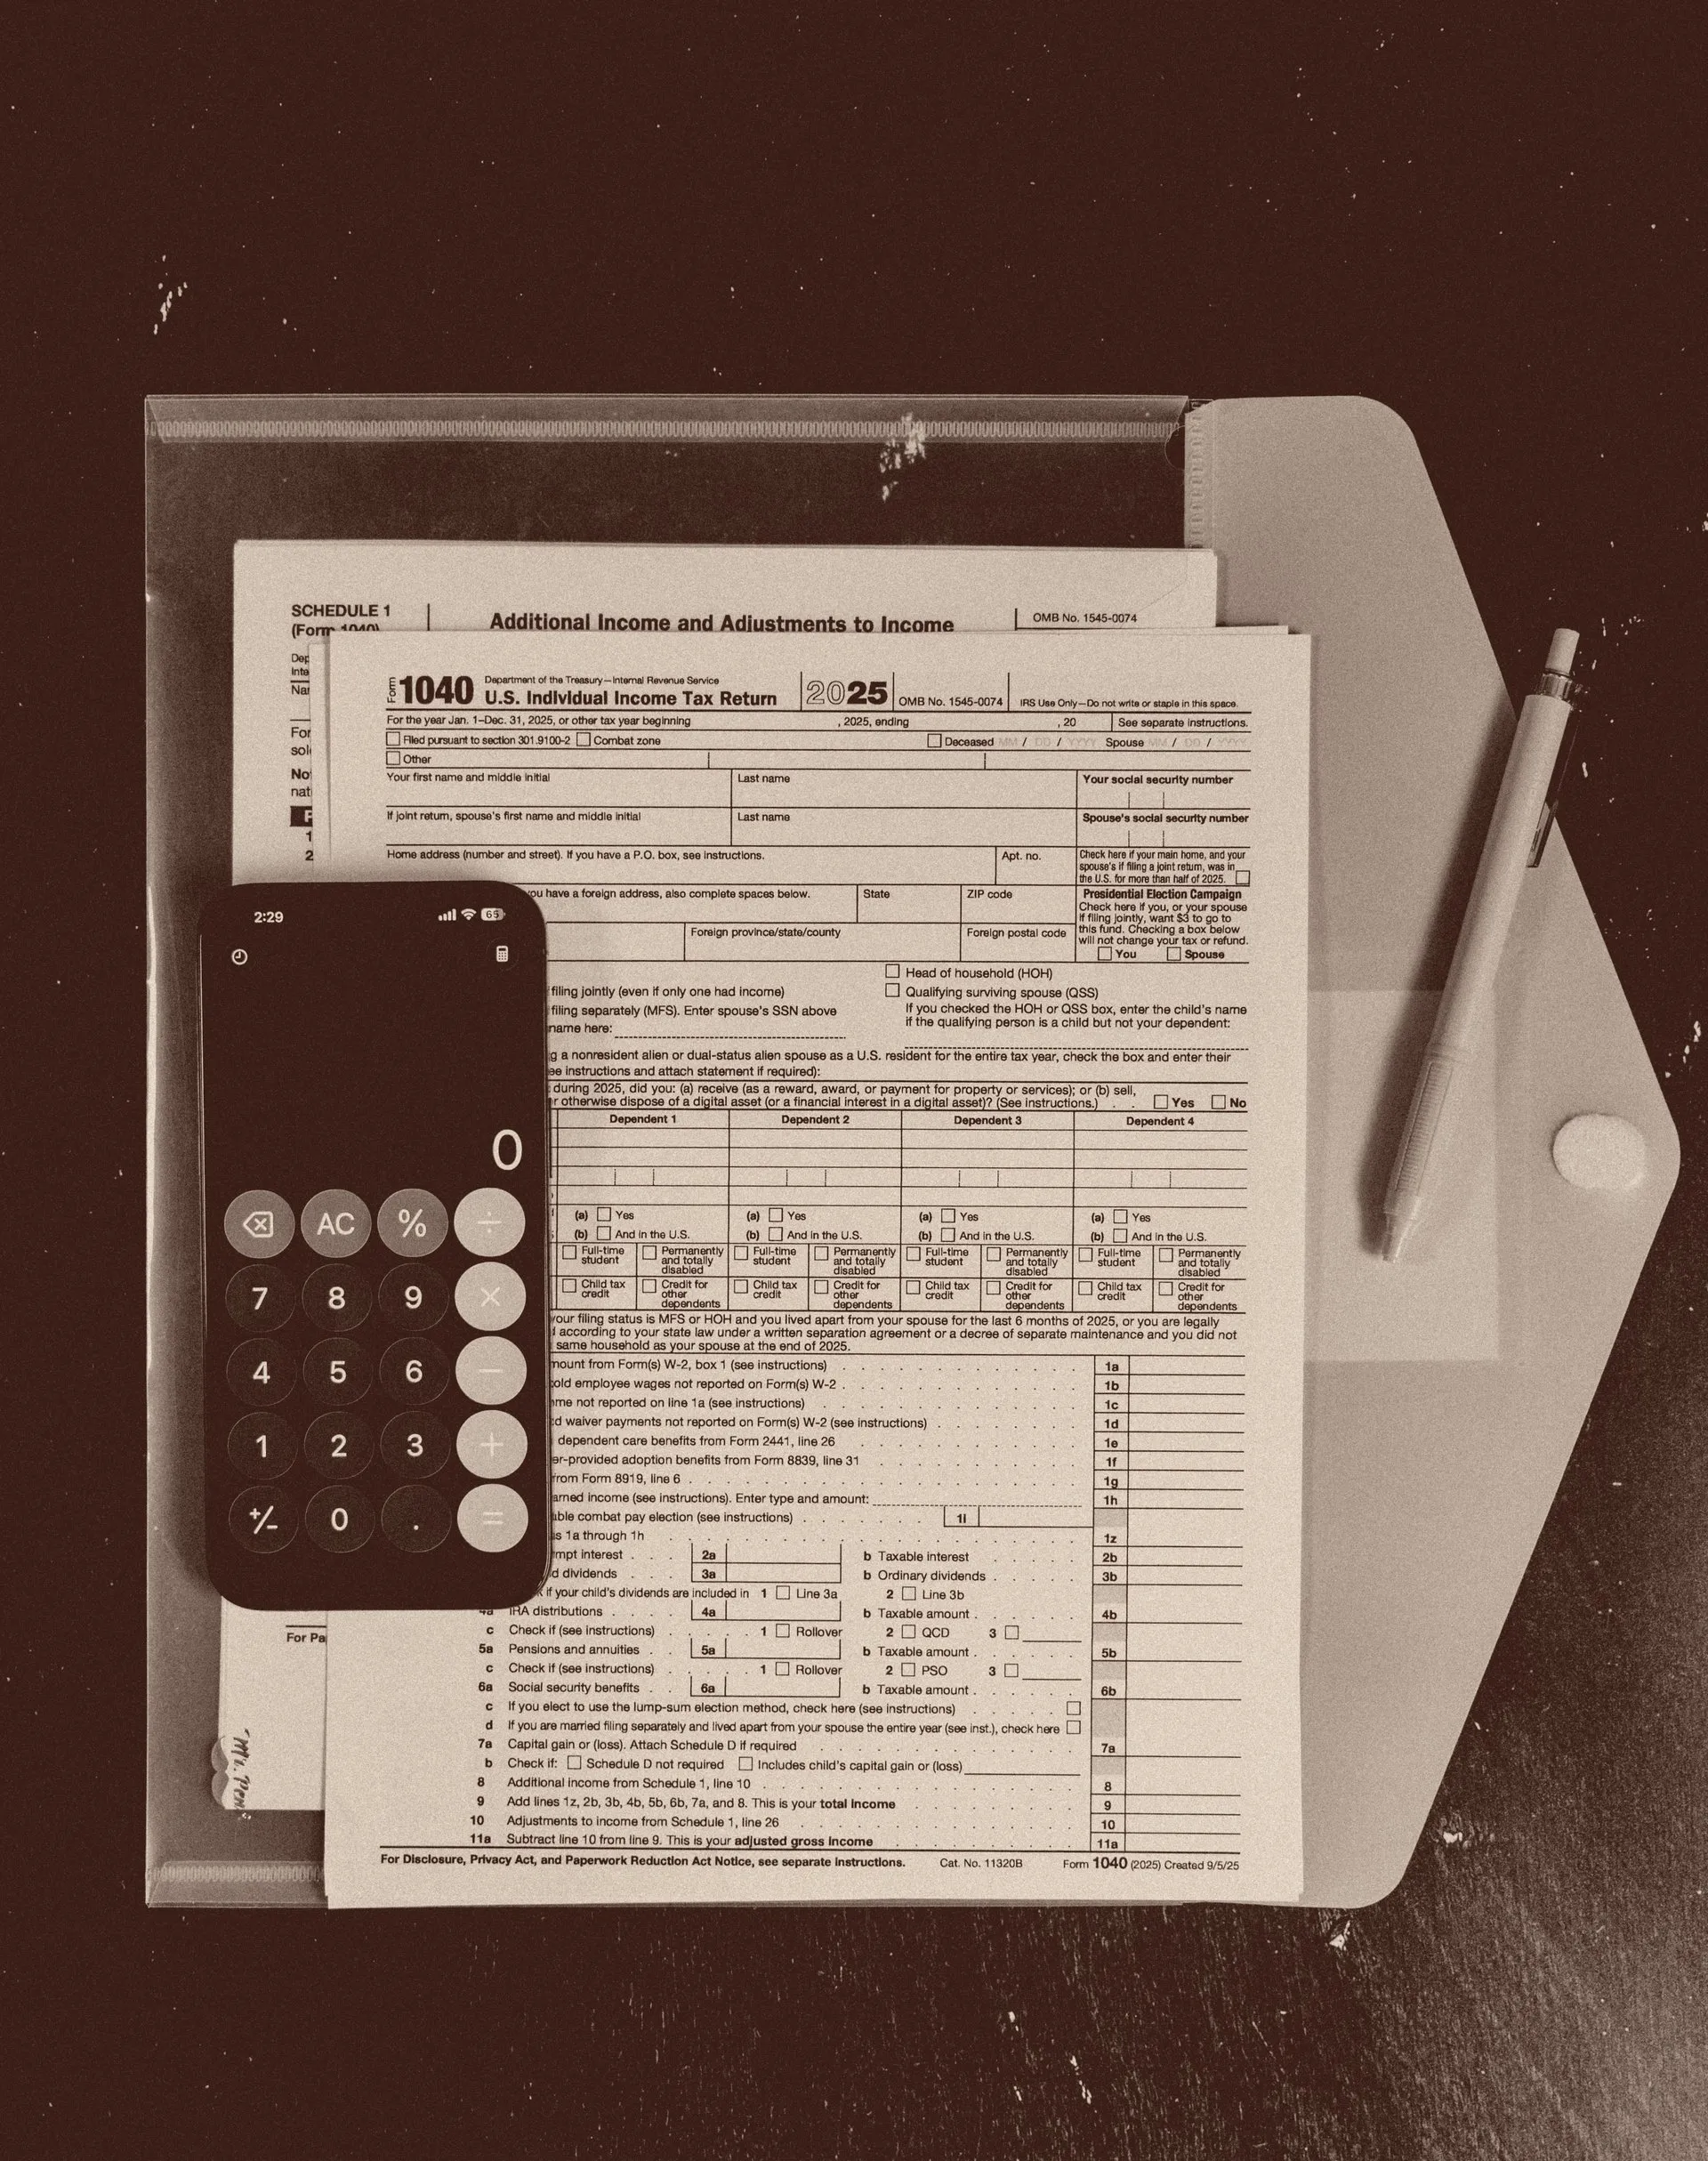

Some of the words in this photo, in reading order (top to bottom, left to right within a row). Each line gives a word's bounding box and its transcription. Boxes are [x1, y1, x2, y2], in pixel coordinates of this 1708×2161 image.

[291, 603, 379, 617] SCHEDULE
[383, 604, 390, 617] 1
[490, 612, 591, 631] Additional
[599, 613, 671, 631] Income
[677, 614, 713, 632] and
[720, 614, 847, 633] Adjustments
[853, 616, 874, 633] to
[881, 616, 955, 633] Income
[1033, 612, 1059, 623] OMB
[1062, 613, 1079, 623] No.
[1084, 613, 1137, 623] 1545-0074
[387, 677, 396, 703] Form
[399, 675, 474, 705] 1040
[806, 680, 889, 706] 2025
[485, 689, 520, 706] U.S.
[527, 689, 608, 706] Individual
[615, 690, 677, 706] Income
[682, 690, 713, 706] Tax
[720, 690, 777, 706] Return
[898, 696, 925, 706] OMB
[928, 697, 946, 706] No.
[949, 697, 1003, 706] 1545-0074
[1020, 698, 1036, 707] IRS
[1038, 699, 1056, 707] Use
[1118, 699, 1140, 707] write
[1153, 700, 1180, 709] staple
[1192, 699, 1208, 708] this
[1210, 701, 1239, 709] space.
[387, 714, 404, 724] For
[406, 715, 422, 724] the
[423, 717, 447, 727] year
[448, 715, 469, 725] Jan.
[510, 715, 525, 726] 31,
[528, 715, 555, 726] 2025,
[559, 717, 569, 725] or
[571, 715, 598, 725] other
[600, 716, 616, 725] tax
[618, 717, 640, 728] year
[642, 716, 691, 728] beginning
[843, 716, 872, 727] 2025,
[874, 717, 909, 729] ending
[1063, 717, 1076, 727] 20
[593, 735, 634, 746] Combat
[636, 738, 661, 746] zone
[945, 737, 995, 746] Deceased
[1106, 738, 1145, 749] Spouse
[403, 754, 431, 764] Other
[387, 772, 410, 782] Your
[413, 772, 432, 782] first
[435, 774, 463, 782] name
[465, 772, 485, 782] and
[487, 772, 522, 782] middle
[525, 773, 550, 782] initial
[737, 773, 760, 783] Last
[761, 775, 791, 783] name
[1083, 774, 1109, 784] Your
[1111, 775, 1143, 785] social
[1146, 775, 1189, 786] security
[1191, 775, 1234, 785] number
[1002, 851, 1022, 862] Apt.
[863, 889, 890, 899] State
[967, 889, 985, 899] ZIP
[987, 890, 1013, 899] code
[254, 911, 284, 923] 2:29
[487, 910, 499, 919] 65
[967, 927, 1005, 939] Foreign
[1007, 928, 1038, 939] postal
[1041, 929, 1067, 938] code
[1116, 949, 1137, 959] You
[1185, 949, 1225, 961] Spouse
[906, 967, 937, 979] Head
[939, 967, 952, 979] of
[955, 968, 1014, 979] household
[1018, 967, 1053, 981] (HOH)
[906, 986, 963, 1000] Qualifying
[966, 987, 1017, 1000] surviving
[1020, 989, 1062, 1000] spouse
[1066, 987, 1099, 1000] (QSS)
[1172, 1097, 1195, 1109] Yes
[1229, 1098, 1247, 1109] No
[609, 1114, 668, 1125] Dependent
[671, 1115, 676, 1124] 1
[781, 1115, 840, 1126] Dependent
[842, 1115, 850, 1125] 2
[954, 1116, 1012, 1127] Dependent
[1015, 1116, 1022, 1125] 3
[1126, 1116, 1185, 1128] Dependent
[1188, 1117, 1195, 1125] 4
[492, 1129, 523, 1171] 0
[317, 1212, 355, 1236] AC
[399, 1209, 426, 1238] %
[582, 1246, 624, 1255] Full-time
[582, 1255, 619, 1265] student
[252, 1286, 268, 1310] 7
[328, 1286, 345, 1310] 8
[405, 1286, 423, 1310] 9
[253, 1361, 270, 1384] 4
[330, 1360, 347, 1383] 5
[406, 1359, 423, 1383] 6
[1105, 1361, 1119, 1372] 1a
[1105, 1399, 1119, 1410] 1c
[256, 1435, 267, 1458] 1
[331, 1434, 347, 1457] 2
[407, 1433, 423, 1457] 3
[1104, 1438, 1118, 1448] 1e
[1103, 1496, 1118, 1505] 1h
[331, 1507, 348, 1531] 0
[878, 1551, 923, 1562] Taxable
[927, 1552, 969, 1562] interest
[286, 1633, 307, 1643] For
[478, 1681, 493, 1692] 6a
[508, 1681, 544, 1693] Social
[546, 1682, 592, 1695] security
[594, 1682, 640, 1693] benefits
[477, 1777, 485, 1787] 8
[507, 1777, 565, 1788] Additional
[568, 1778, 610, 1788] income
[613, 1778, 640, 1788] from
[642, 1778, 697, 1789] Schedule
[699, 1778, 709, 1790] 1,
[713, 1778, 733, 1789] line
[737, 1778, 751, 1789] 10
[381, 1853, 400, 1865] For
[403, 1853, 466, 1866] Disclosure,
[470, 1854, 511, 1867] Privacy
[514, 1854, 537, 1867] Act,
[540, 1855, 562, 1865] and
[565, 1854, 627, 1867] Paperwork
[630, 1855, 689, 1867] Reduction
[691, 1856, 712, 1867] Act
[714, 1856, 755, 1868] Notice,
[758, 1859, 778, 1867] see
[782, 1858, 832, 1868] separate
[834, 1857, 906, 1867] instructions.
[939, 1858, 960, 1868] Cat.
[963, 1859, 980, 1868] No.
[985, 1859, 1023, 1868] 11320B
[1063, 1859, 1089, 1869] Form
[1092, 1856, 1128, 1869] 1040
[1131, 1859, 1161, 1871] (2025)
[1164, 1860, 1204, 1870] Created
[1207, 1860, 1239, 1871] 9/5/25
